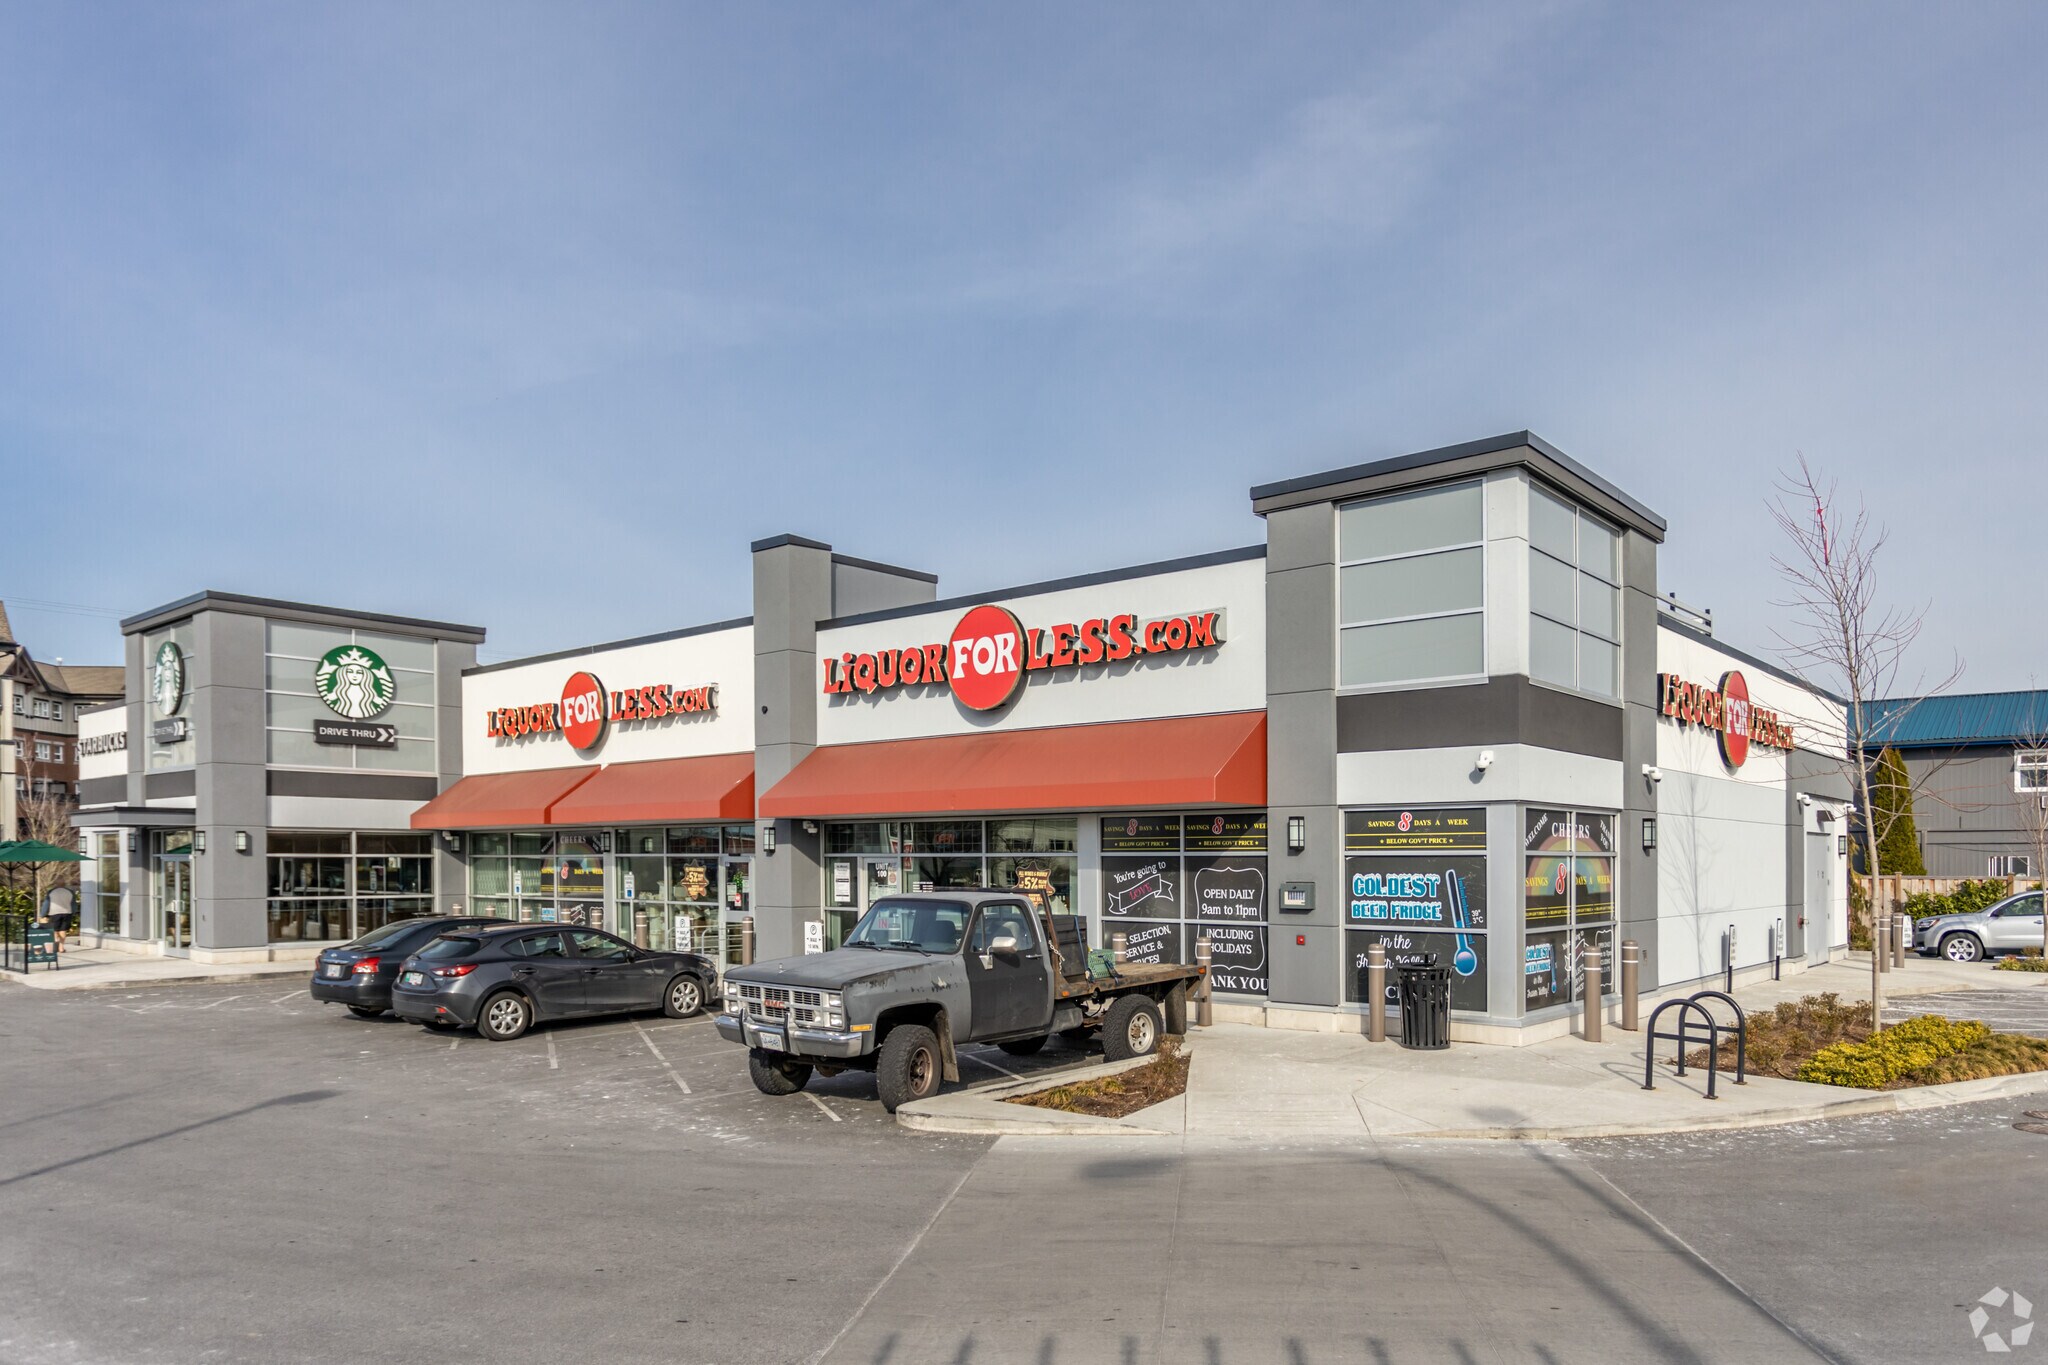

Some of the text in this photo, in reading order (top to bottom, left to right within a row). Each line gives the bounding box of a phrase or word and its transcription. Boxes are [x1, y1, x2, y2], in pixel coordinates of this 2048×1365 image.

[952, 632, 1018, 679] FOR
[1025, 612, 1217, 671] LESS.COM
[563, 690, 600, 728] FOR
[610, 684, 710, 722] LESS.COM
[1725, 697, 1749, 737] FOR
[319, 726, 376, 739] DRIVE THRU
[77, 730, 127, 757] STARBUCKS
[1104, 825, 1125, 833] SAVINGS
[1126, 818, 1138, 836] 8
[1212, 816, 1224, 835] 8
[1398, 812, 1412, 832] 8
[560, 835, 587, 844] CHEERS
[877, 870, 887, 878] 100
[1114, 861, 1167, 884] You're going to
[1555, 862, 1567, 895] 8
[1024, 876, 1038, 889] 5%
[1352, 872, 1441, 898] COLDEST
[1129, 883, 1153, 900] LOVE
[1203, 888, 1255, 900] OPEN DAILY
[1201, 903, 1257, 918] 9am to 11pm
[1351, 900, 1443, 921] BEER FRIDGE
[1472, 916, 1484, 924] 3°C
[1129, 924, 1171, 945] SELECTION,
[1206, 928, 1254, 940] INCLUDING
[1380, 934, 1412, 949] in the
[1125, 942, 1156, 958] SERVICE
[1157, 940, 1164, 950] &
[1132, 954, 1160, 964] ICES!
[1356, 953, 1395, 969] Frr
[1211, 974, 1268, 991] ANK YOU
[764, 999, 785, 1009] GMC
